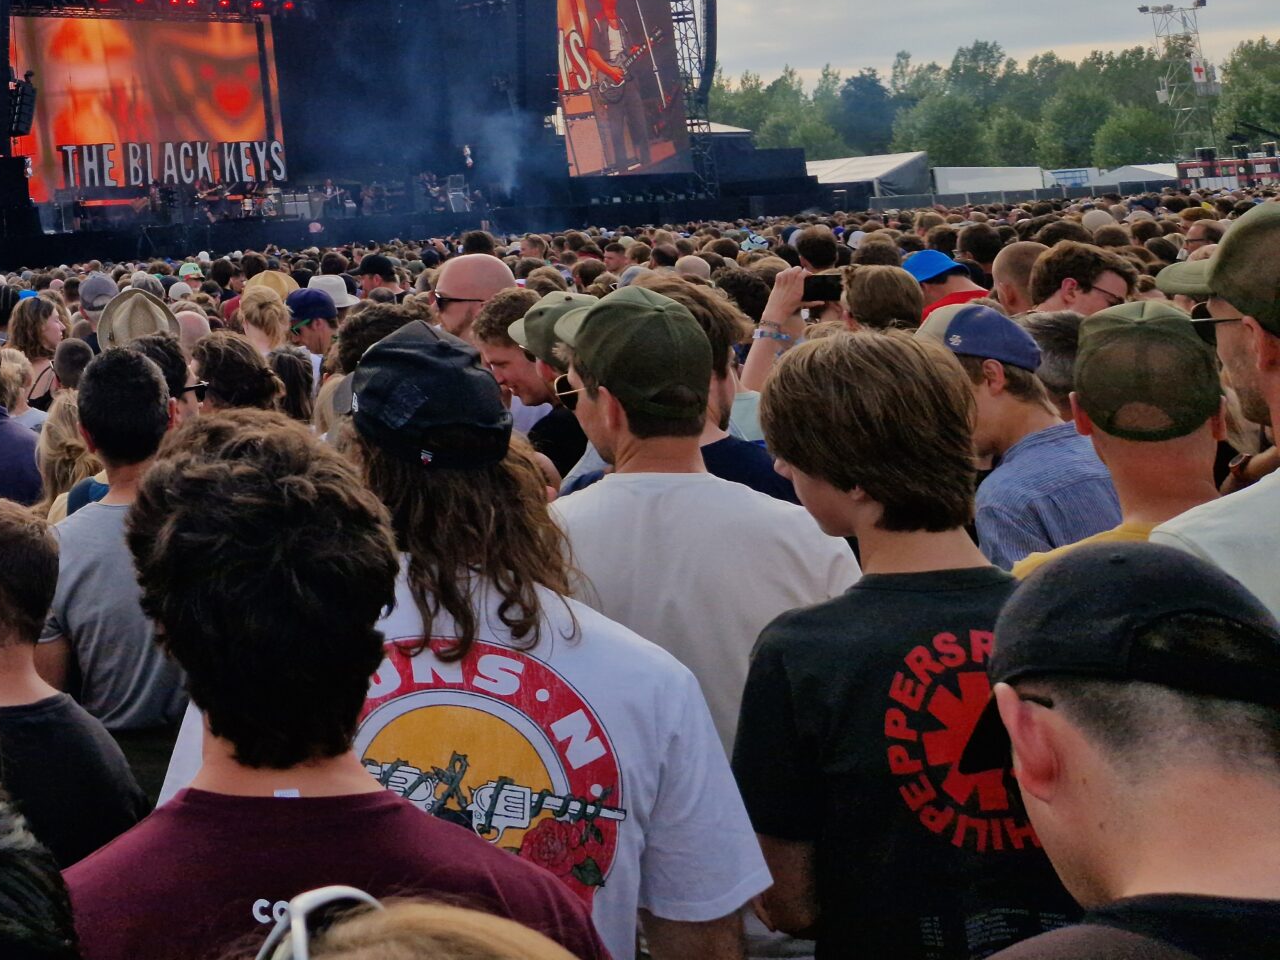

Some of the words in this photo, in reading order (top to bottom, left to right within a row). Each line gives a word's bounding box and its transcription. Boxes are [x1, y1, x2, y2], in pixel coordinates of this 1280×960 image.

[62, 143, 117, 187] THE
[128, 142, 212, 186] BLACK
[223, 140, 286, 183] KEYS
[884, 632, 966, 833] PEPPERS
[951, 814, 1042, 852] HILI
